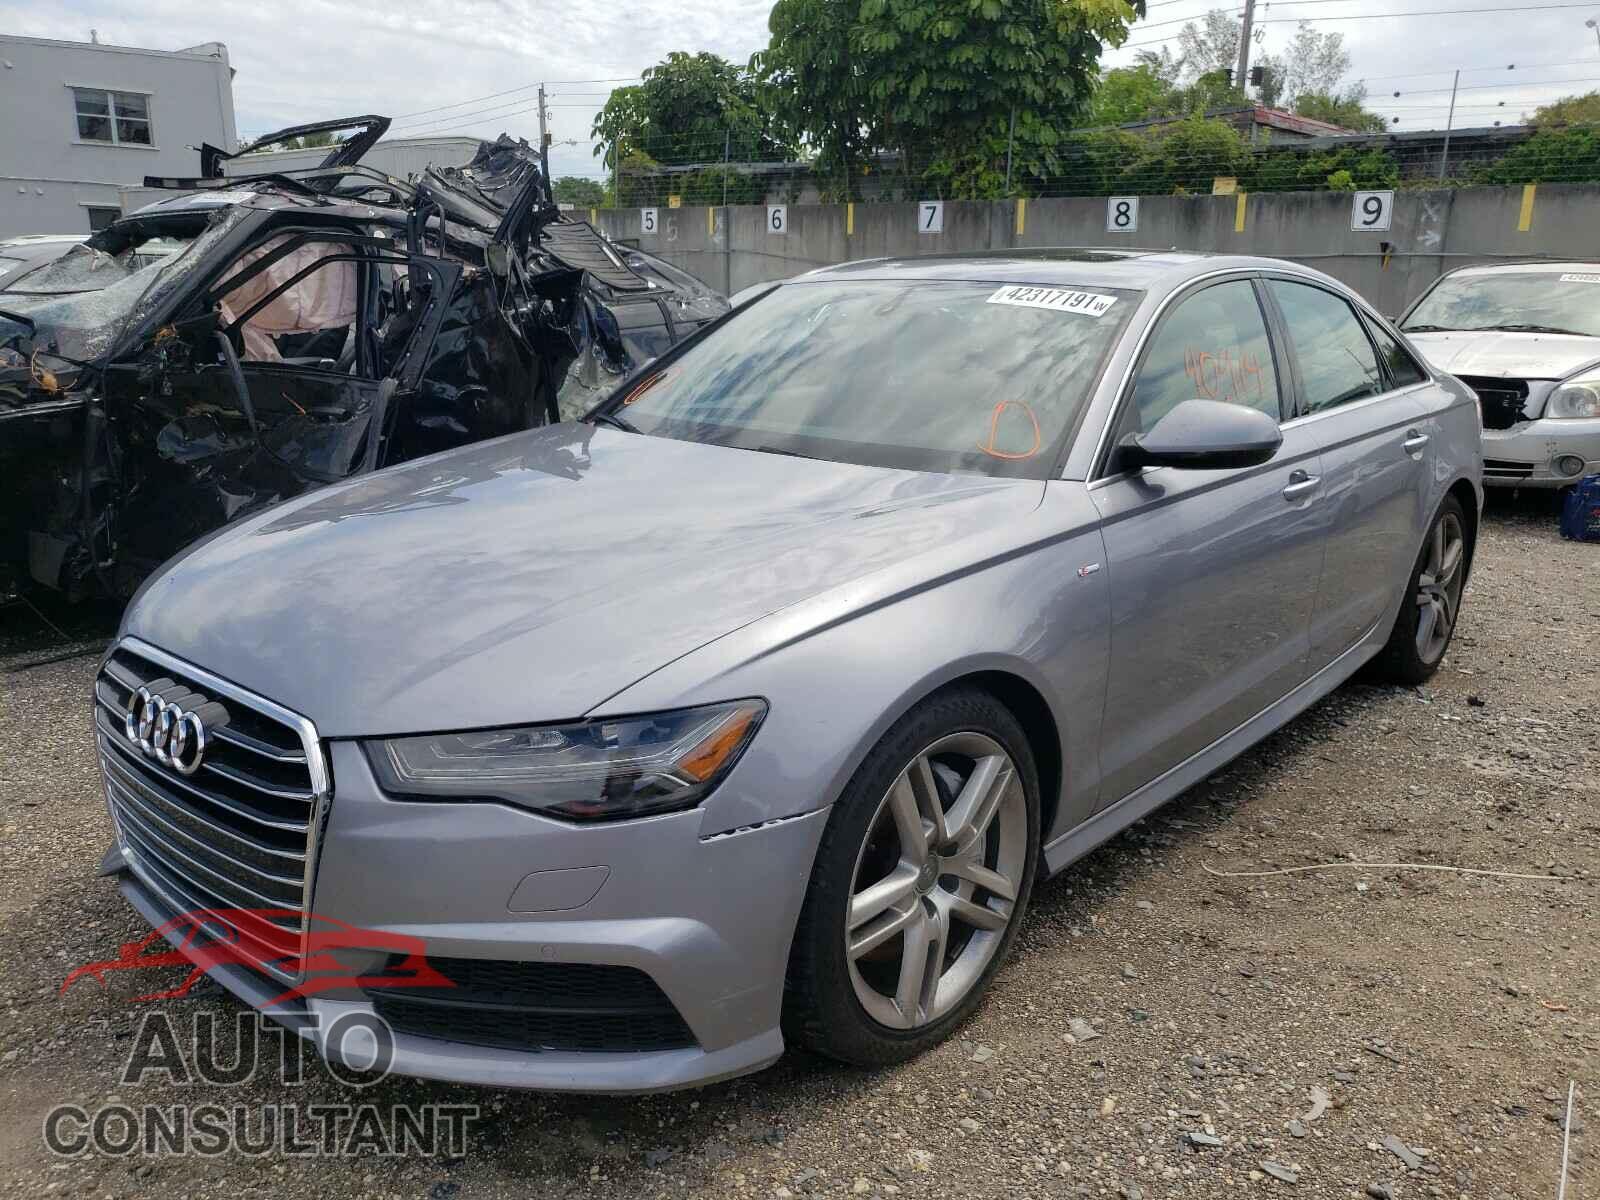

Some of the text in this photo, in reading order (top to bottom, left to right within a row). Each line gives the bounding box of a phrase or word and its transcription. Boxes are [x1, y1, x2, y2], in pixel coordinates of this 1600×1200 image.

[645, 211, 654, 231] 5
[772, 209, 782, 230] 6
[925, 205, 937, 229] 7
[1114, 201, 1130, 227] 8
[1362, 196, 1382, 226] 9
